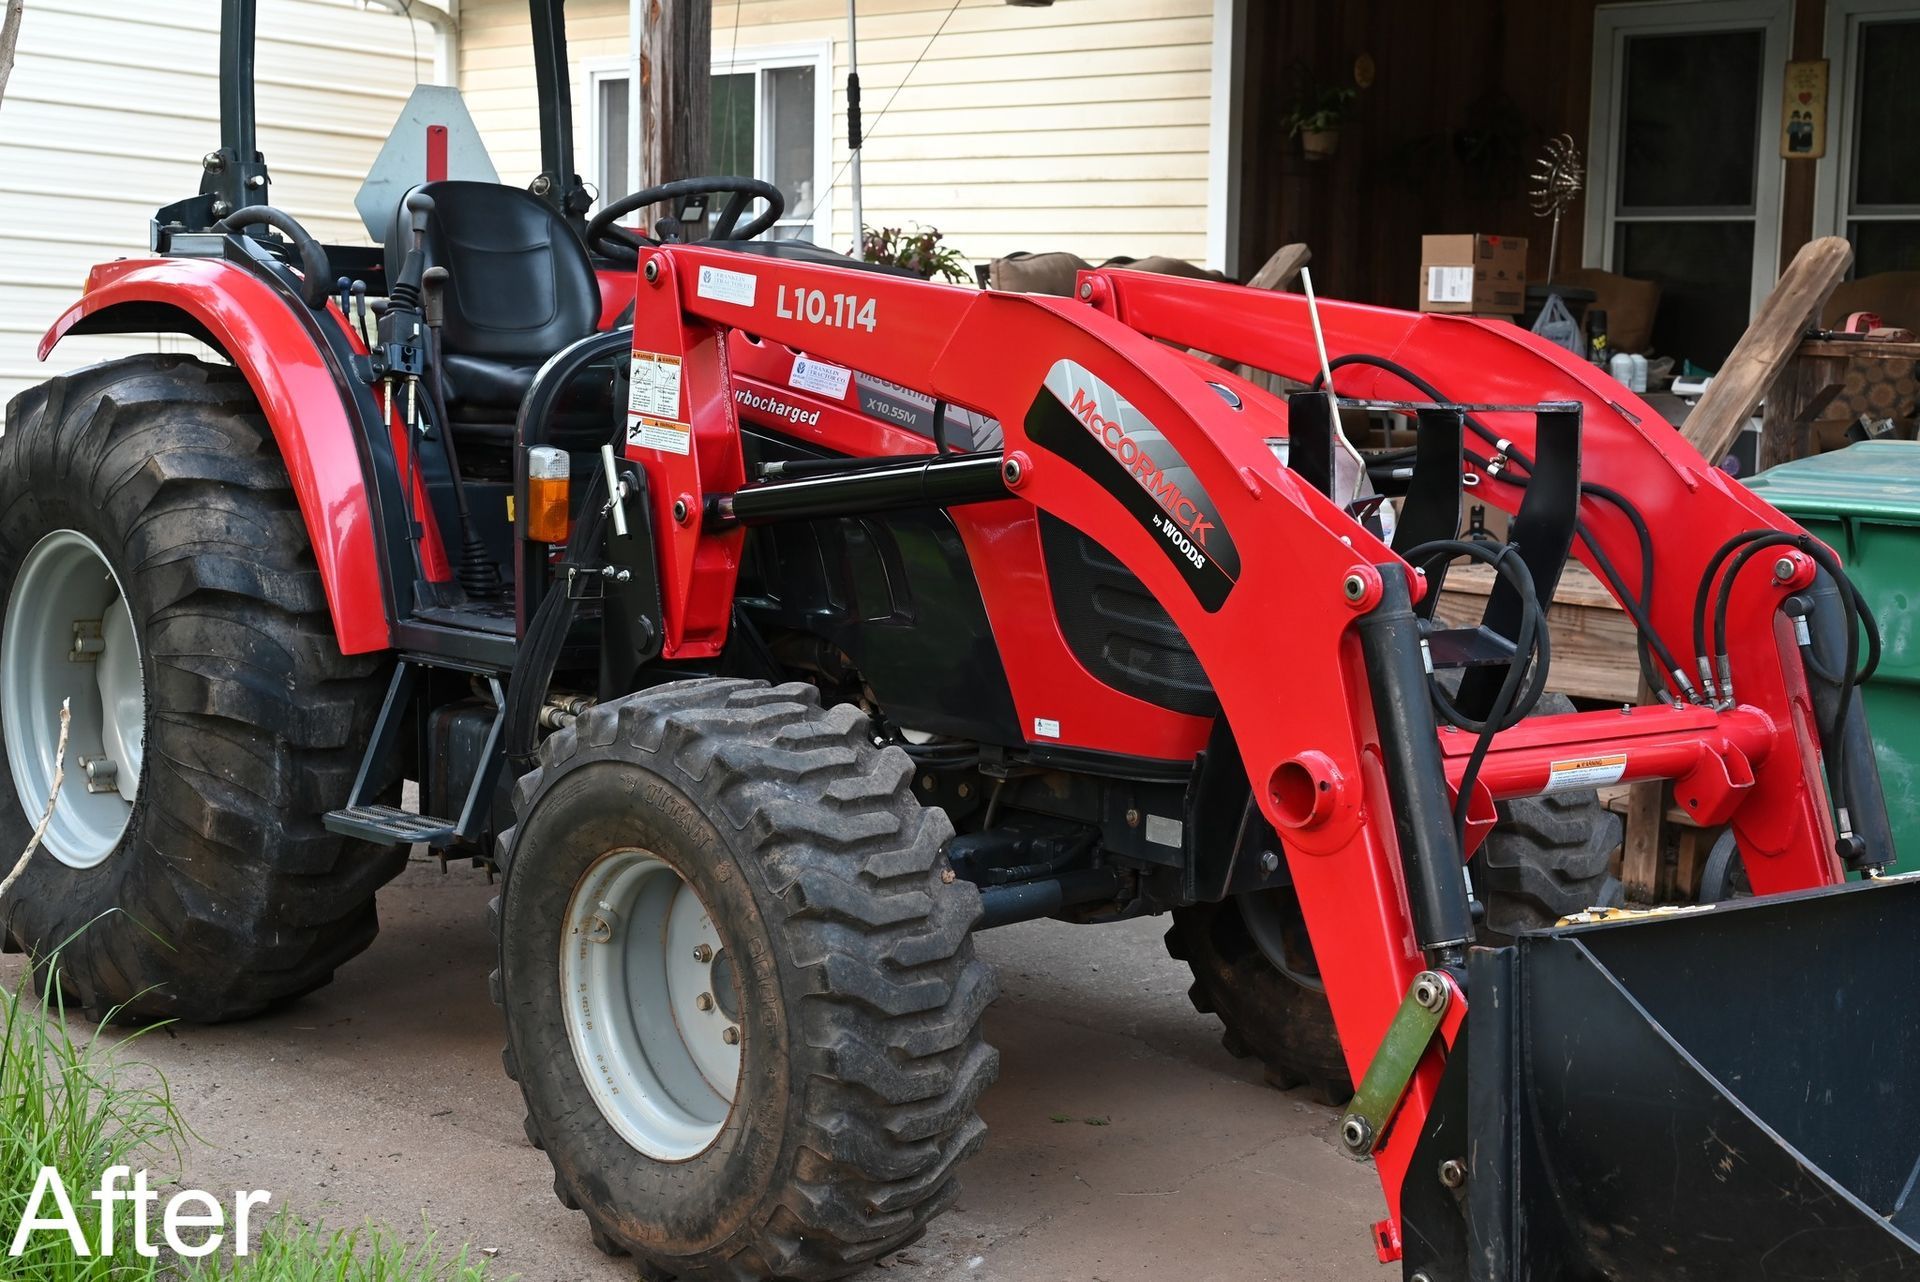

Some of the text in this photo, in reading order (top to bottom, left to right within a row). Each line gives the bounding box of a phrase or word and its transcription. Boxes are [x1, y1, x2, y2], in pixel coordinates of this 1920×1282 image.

[776, 285, 877, 333] L10.114
[810, 364, 839, 376] FRANKLIN
[866, 398, 917, 425] X10.55M
[1070, 387, 1215, 547] McCORMICK
[1152, 514, 1206, 570] by WOODS
[643, 783, 713, 848] TITAN
